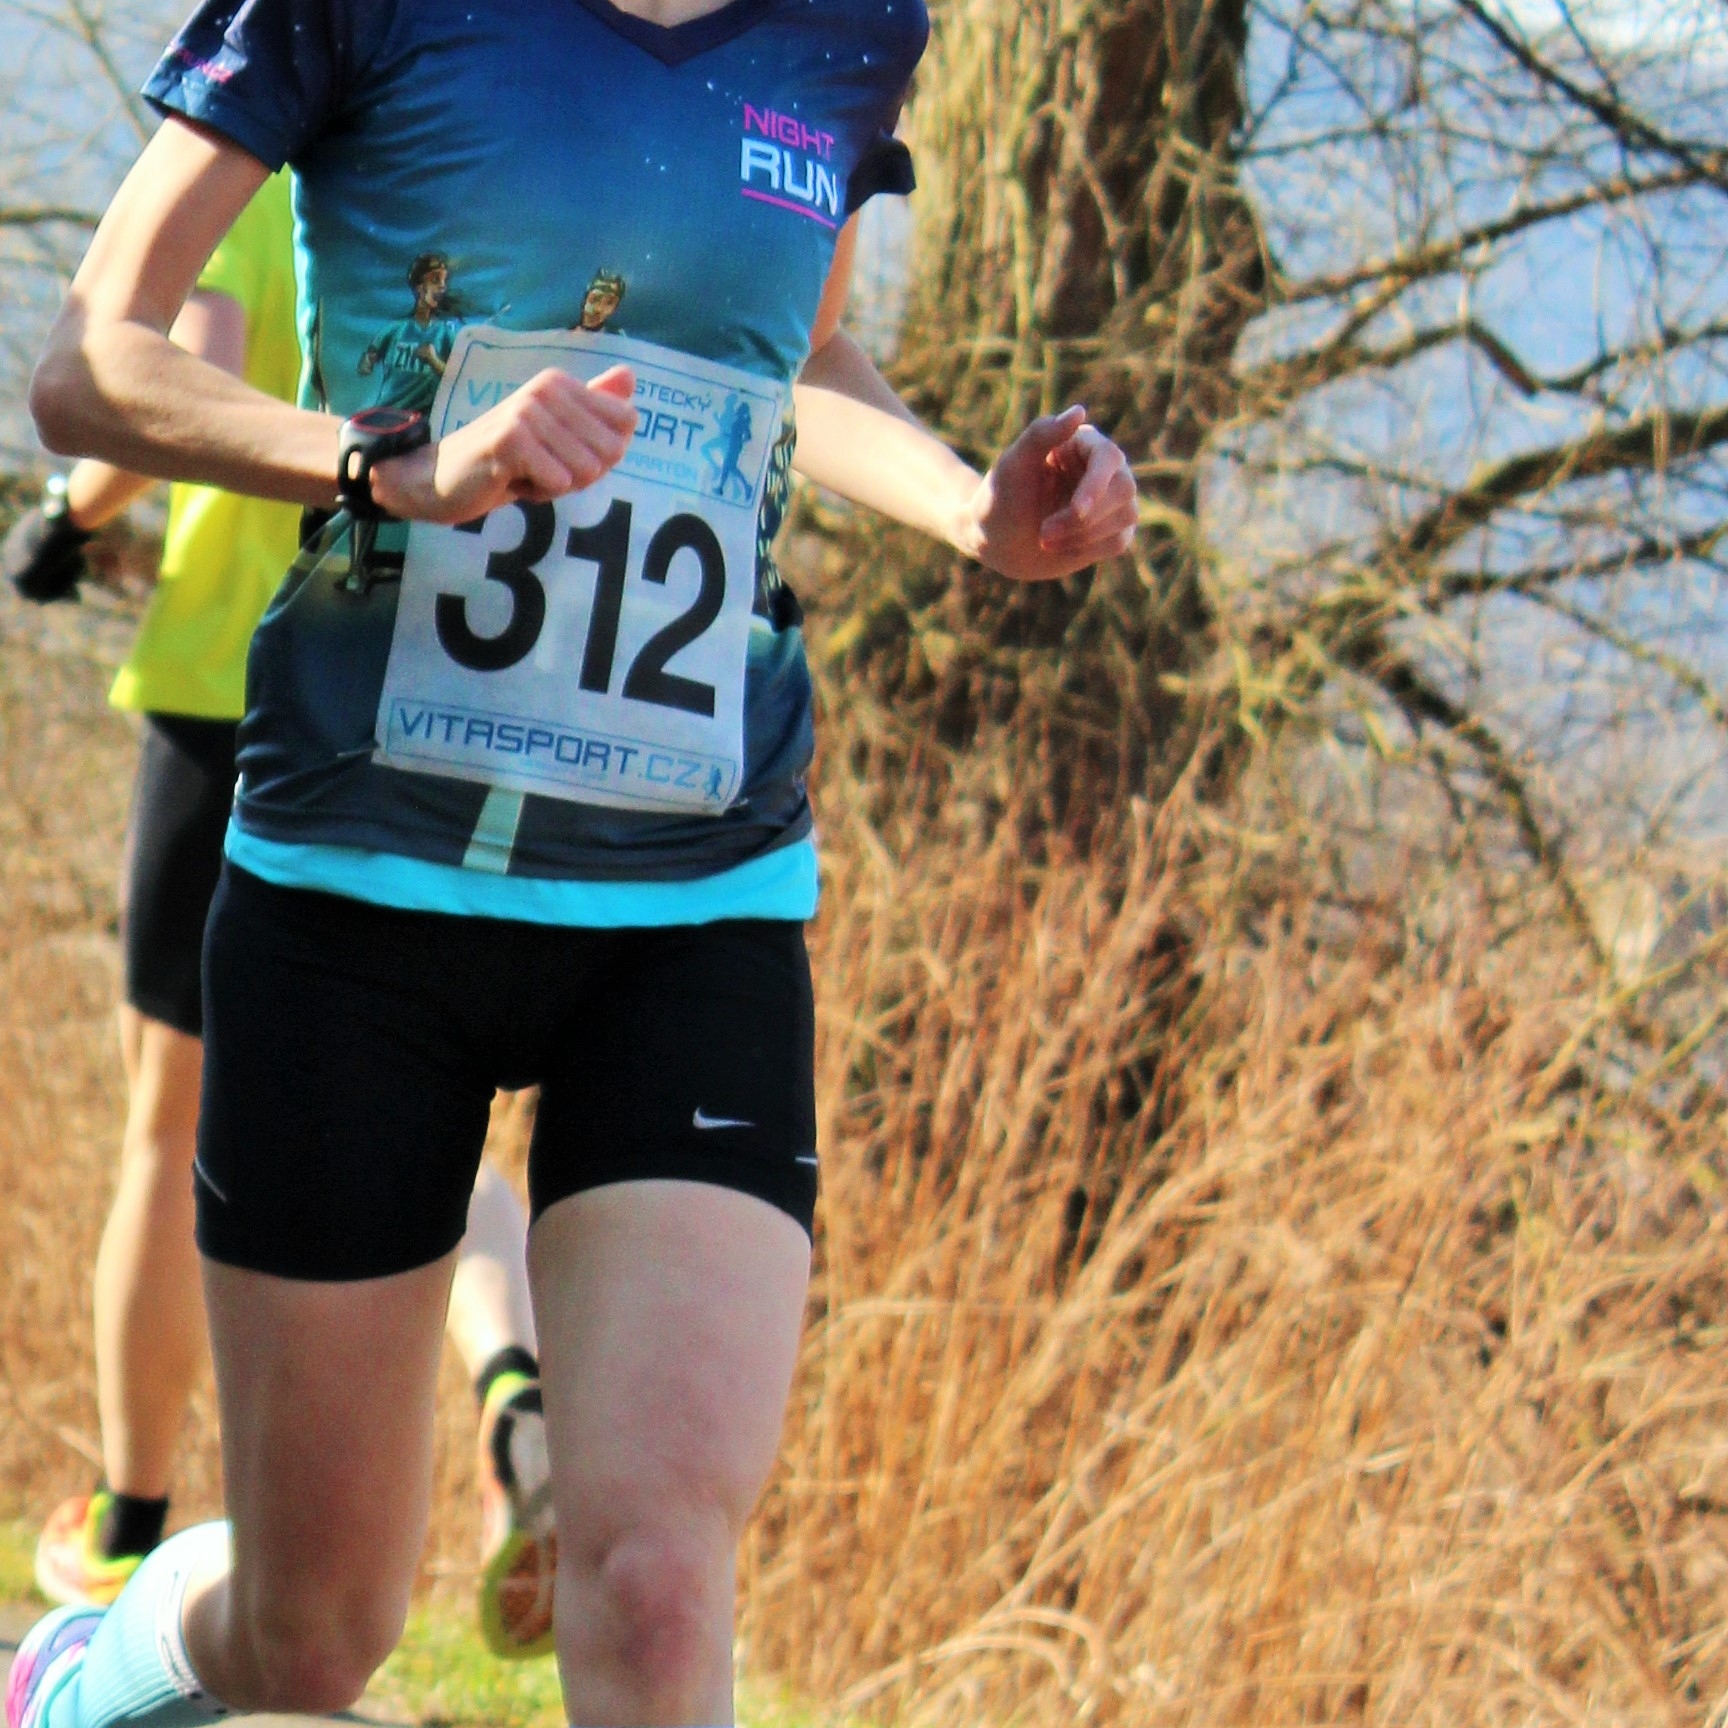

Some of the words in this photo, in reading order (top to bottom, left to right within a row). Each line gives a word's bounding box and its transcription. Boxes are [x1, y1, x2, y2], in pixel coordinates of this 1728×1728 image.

[743, 103, 834, 161] NIGHT
[740, 137, 838, 216] RUN
[635, 379, 712, 412] STECKÝ
[434, 498, 726, 718] 312
[399, 707, 701, 789] VITASPORT.CZ
